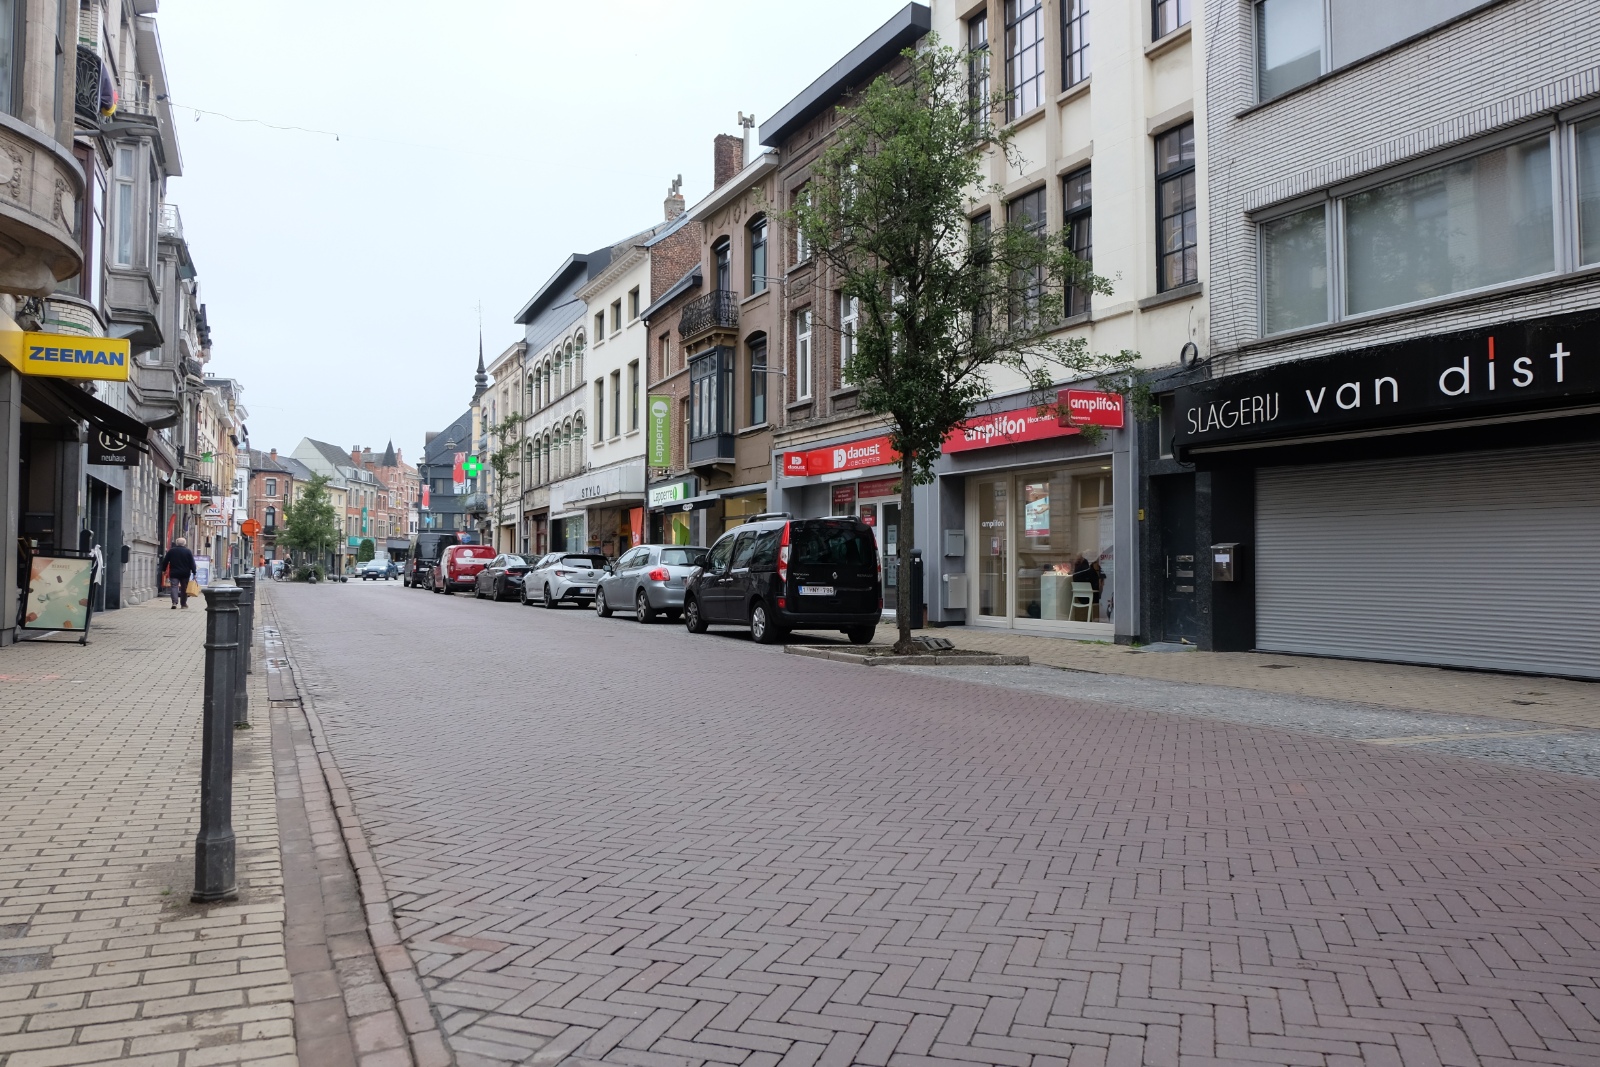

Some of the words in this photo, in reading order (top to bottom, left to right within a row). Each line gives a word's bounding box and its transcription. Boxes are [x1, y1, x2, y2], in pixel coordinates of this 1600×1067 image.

[29, 346, 124, 366] ZEEMAN
[1187, 391, 1280, 435] SLAGERIJ
[1305, 375, 1398, 414] van
[1438, 336, 1571, 396] dist
[1070, 397, 1120, 412] amplifon
[964, 415, 1026, 443] amplifon
[655, 417, 664, 462] Lapperre
[101, 454, 126, 462] neuhaus
[848, 444, 880, 459] daoust
[581, 485, 601, 498] STYLO
[653, 487, 673, 503] Lapperre
[982, 519, 1005, 529] amplifon
